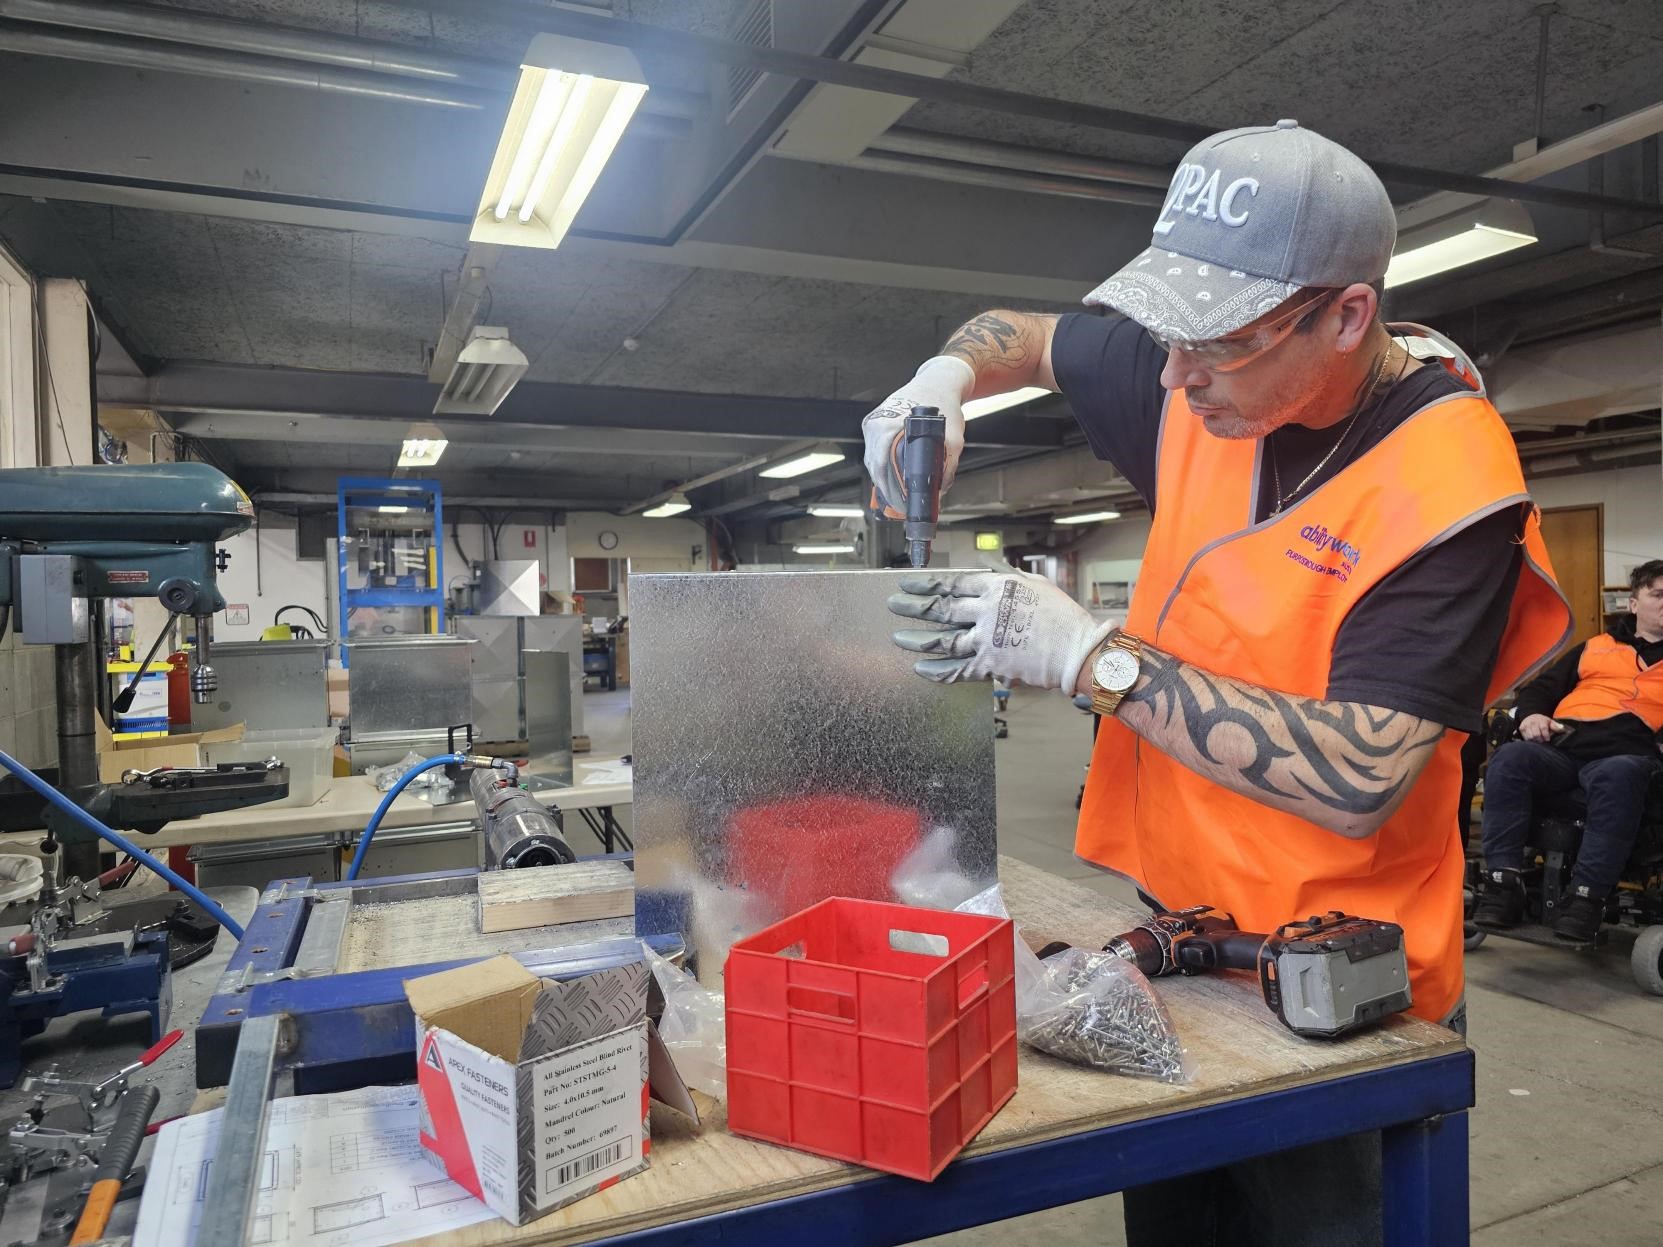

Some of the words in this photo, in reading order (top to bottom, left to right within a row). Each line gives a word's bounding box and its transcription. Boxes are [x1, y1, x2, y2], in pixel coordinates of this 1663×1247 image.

[448, 1057, 466, 1074] APEX
[466, 1067, 509, 1097] FASTENERS
[543, 1072, 553, 1081] All
[554, 1063, 582, 1077] Stainless
[582, 1056, 598, 1067] Steel
[599, 1050, 616, 1061] Blind
[616, 1044, 632, 1055] Rivet
[460, 1082, 481, 1097] QUALITY
[481, 1093, 511, 1115] FASTENERS
[543, 1086, 559, 1097] Part
[560, 1081, 572, 1090] No:
[544, 1101, 560, 1113] Size:
[563, 1089, 590, 1105] 4.0x10.5
[591, 1085, 604, 1095] mm
[544, 1113, 574, 1128] Mandrel
[575, 1103, 600, 1117] Colour:
[601, 1092, 626, 1106] Natural
[545, 1133, 561, 1145] Qty:
[563, 1127, 576, 1136] 500
[545, 1147, 565, 1160] Batch
[566, 1135, 596, 1150] Number:
